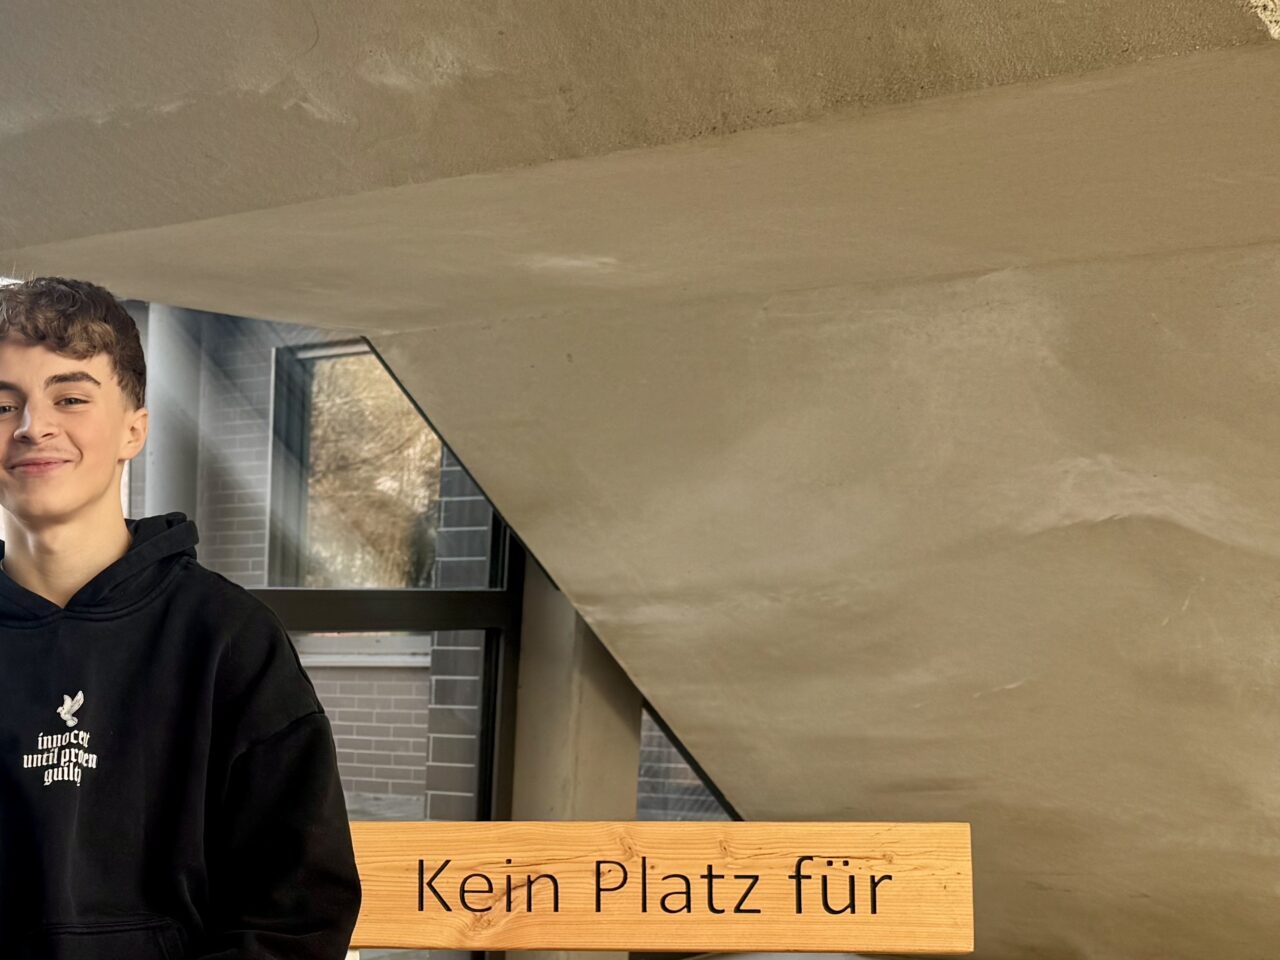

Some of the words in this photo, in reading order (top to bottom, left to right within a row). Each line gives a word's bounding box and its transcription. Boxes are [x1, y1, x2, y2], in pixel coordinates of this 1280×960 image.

[22, 748, 59, 769] until
[60, 748, 98, 769] proen
[418, 857, 560, 914] Kein
[595, 857, 761, 914] Platz
[788, 855, 894, 915] für
